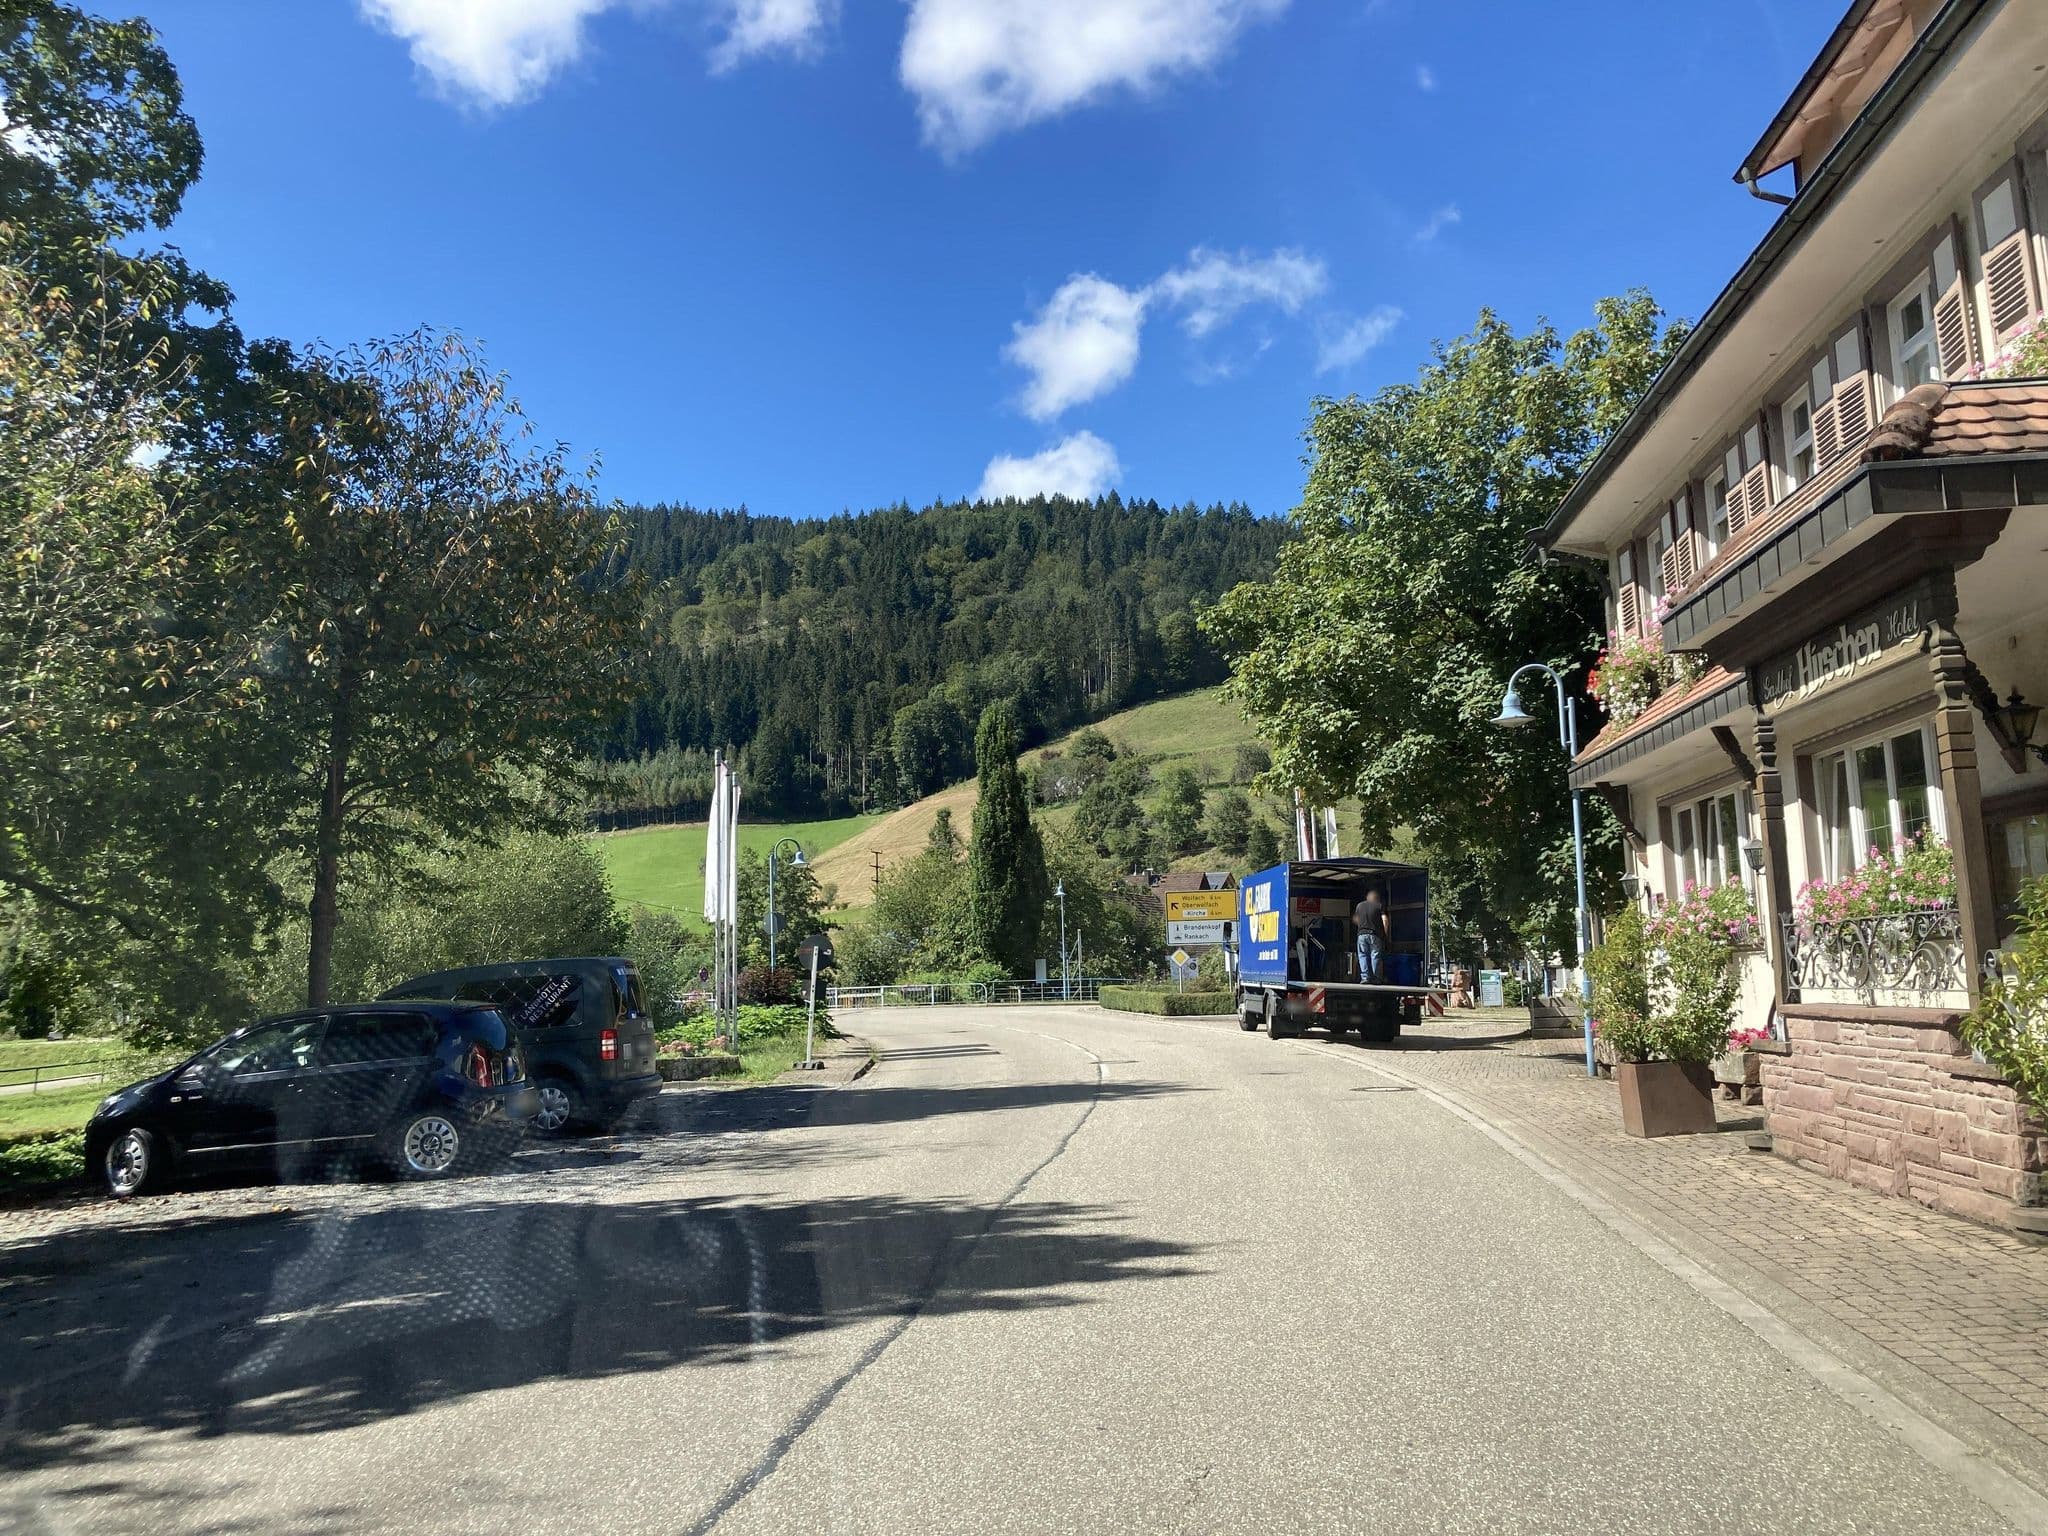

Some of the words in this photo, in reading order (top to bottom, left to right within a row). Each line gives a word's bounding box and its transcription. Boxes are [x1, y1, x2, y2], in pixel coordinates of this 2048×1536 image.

[1796, 624, 1882, 700] Hirschen
[1886, 600, 1920, 642] Hotel
[520, 981, 560, 1020] LANDHOTEL
[529, 979, 571, 1023] RESTAURANT
